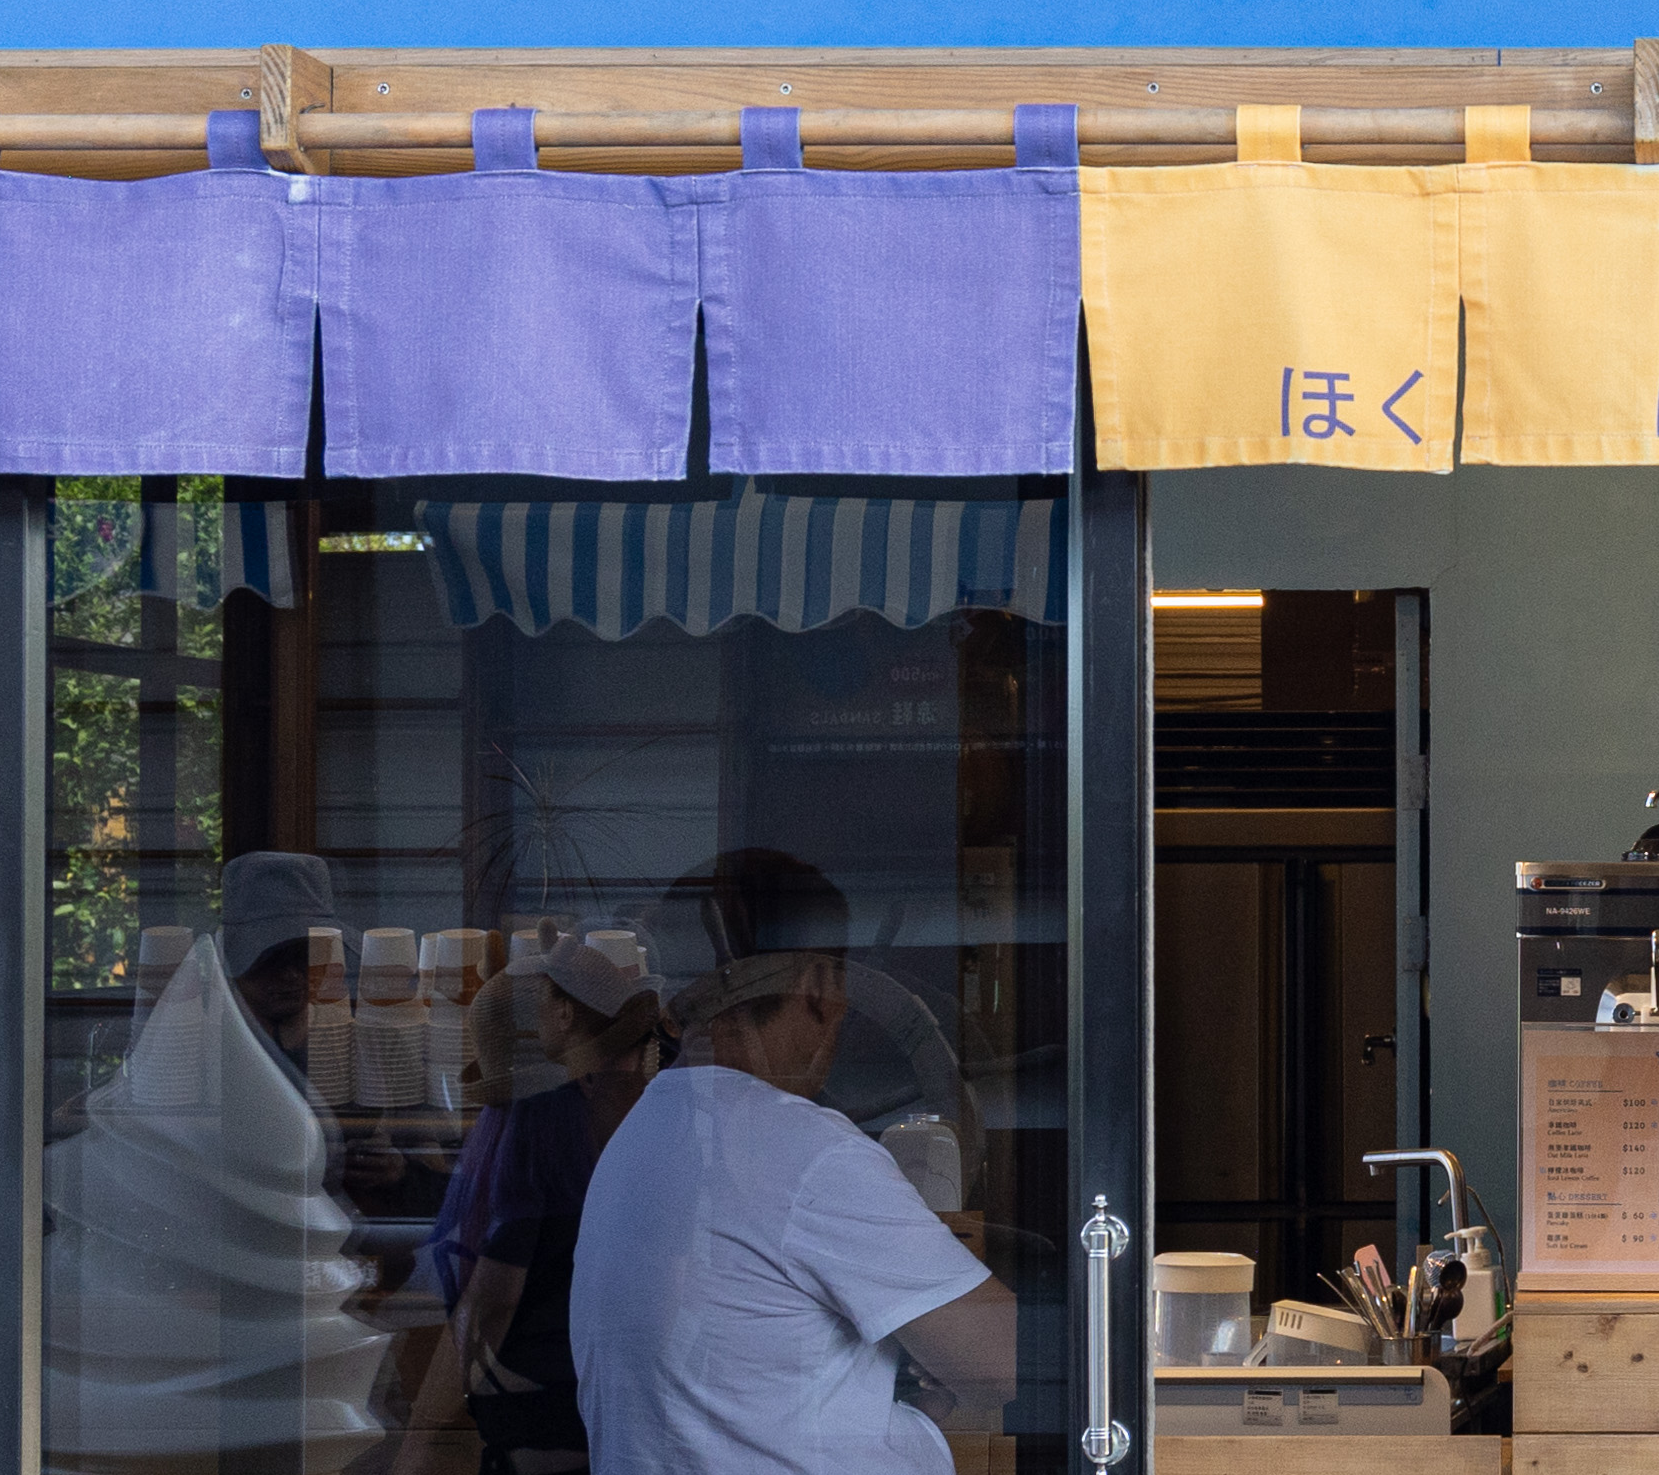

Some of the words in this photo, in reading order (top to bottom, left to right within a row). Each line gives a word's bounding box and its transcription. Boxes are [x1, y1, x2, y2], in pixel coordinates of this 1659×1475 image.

[1280, 367, 1423, 445] ほく
[1623, 1099, 1646, 1107] $100
[1623, 1122, 1646, 1130] $120
[1622, 1144, 1646, 1152] $140
[1622, 1166, 1646, 1175] $120
[1568, 1193, 1608, 1201] DESSERT
